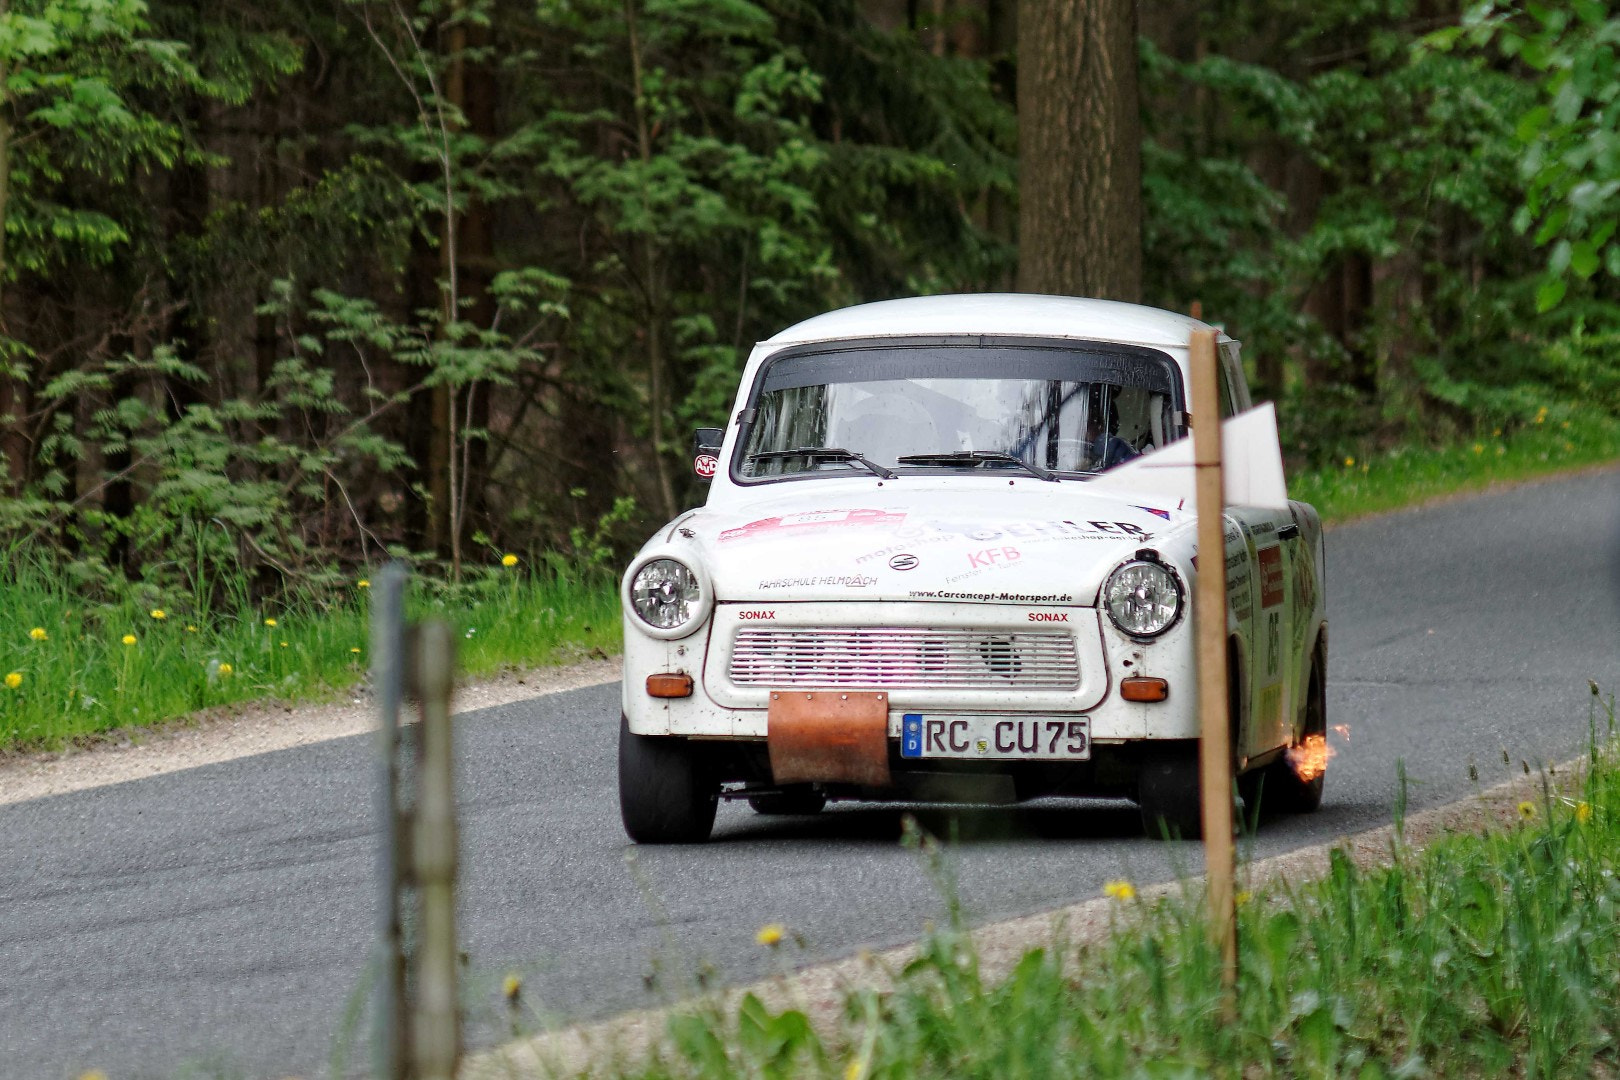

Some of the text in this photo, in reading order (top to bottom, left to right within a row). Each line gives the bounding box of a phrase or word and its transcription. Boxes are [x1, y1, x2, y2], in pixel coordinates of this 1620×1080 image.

[967, 546, 1021, 569] KFB
[758, 574, 878, 590] FAHRSCHULE HELMDACH
[909, 590, 1073, 604] www.Carconcept-Motorsport.de
[739, 611, 776, 620] SONAX
[1028, 612, 1069, 622] SONAX
[909, 740, 917, 750] D
[926, 720, 970, 753] RC
